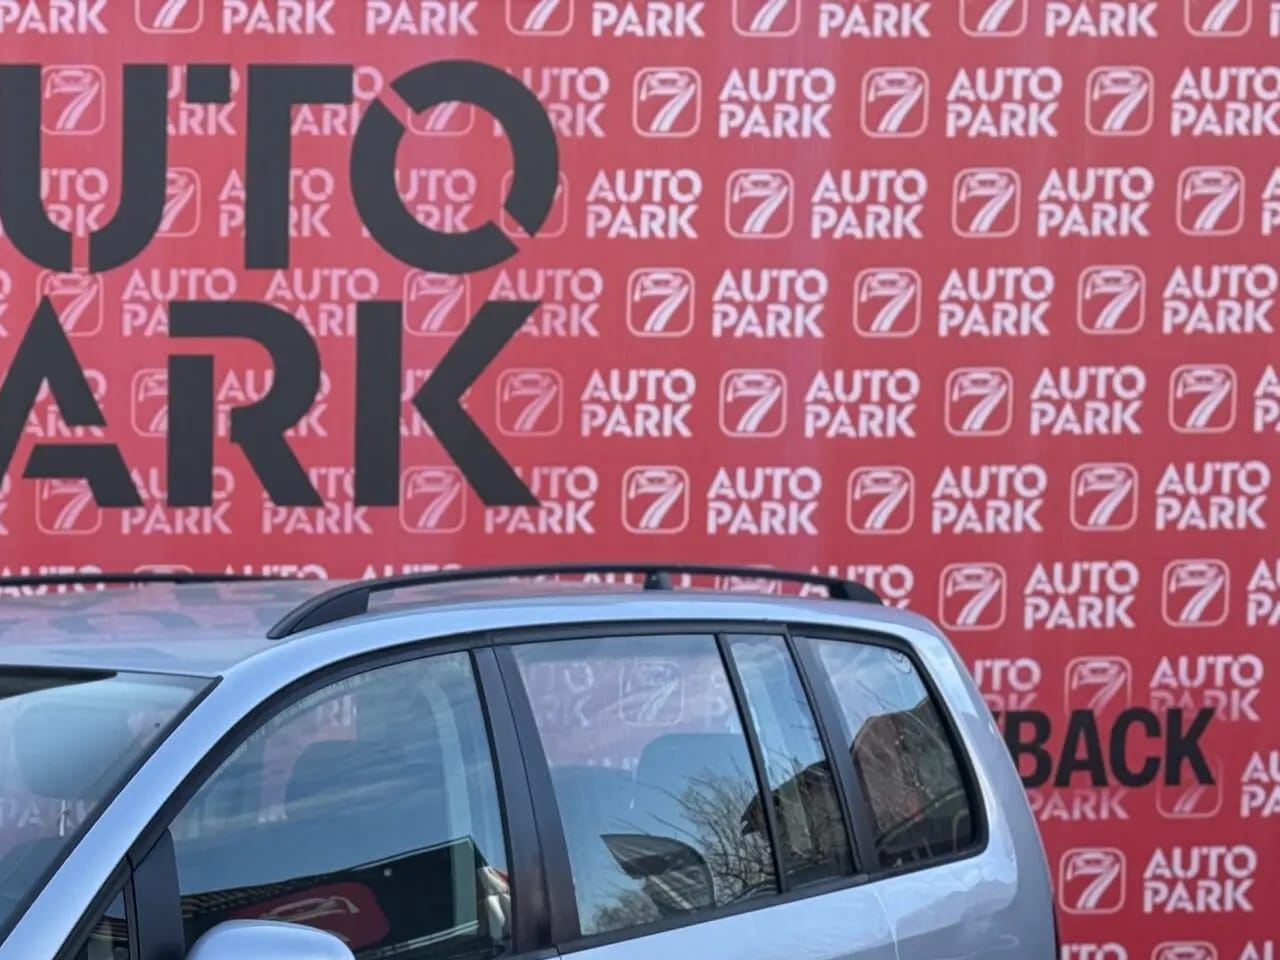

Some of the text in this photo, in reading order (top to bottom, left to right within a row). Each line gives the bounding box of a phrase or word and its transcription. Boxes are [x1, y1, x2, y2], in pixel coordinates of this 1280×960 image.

[223, 0, 334, 34] PARK
[367, 0, 477, 35] PARK
[592, 2, 704, 36] PARK
[819, 3, 930, 37] PARK
[1046, 3, 1156, 36] PARK
[506, 66, 609, 100] UTO
[720, 68, 835, 102] AUTO
[947, 67, 1062, 101] AUTO
[1172, 67, 1280, 100] AUTO
[719, 104, 831, 138] PARK
[947, 102, 1057, 137] PARK
[1171, 102, 1280, 136] PARK
[218, 168, 334, 202] ATO
[394, 169, 477, 202] UTO
[587, 169, 702, 203] AUTO
[812, 169, 927, 203] AUTO
[1038, 167, 1153, 201] AUTO
[587, 205, 697, 238] PARK
[812, 205, 922, 239] PARK
[1038, 203, 1149, 236] PARK
[122, 268, 238, 300] AUTO
[265, 268, 380, 300] AUTO
[488, 268, 604, 301] AUTO
[713, 269, 828, 302] AUTO
[939, 267, 1054, 301] AUTO
[1164, 264, 1278, 298] AUTO
[713, 304, 823, 337] PARK
[939, 302, 1050, 336] PARK
[1163, 300, 1273, 333] PARK
[582, 369, 696, 402] AUTO
[805, 369, 919, 402] AUTO
[1031, 366, 1145, 400] AUTO
[582, 404, 691, 437] PARK
[805, 404, 915, 438] PARK
[1031, 401, 1141, 435] PARK
[129, 466, 235, 500] AUO
[514, 466, 598, 499] UTO
[707, 467, 821, 500] AUTO
[932, 465, 1046, 498] AUTO
[1156, 461, 1270, 495] AUTO
[121, 502, 233, 534] PARK
[262, 502, 373, 534] PARK
[484, 501, 595, 534] PARK
[707, 501, 817, 534] PARK
[932, 499, 1042, 533] PARK
[1156, 496, 1266, 530] PARK
[1024, 561, 1139, 594] AUTO
[1024, 594, 1134, 629] PARK
[1150, 654, 1264, 688] AUTO
[1144, 845, 1256, 878] AUTO
[1144, 878, 1253, 912] PARK
